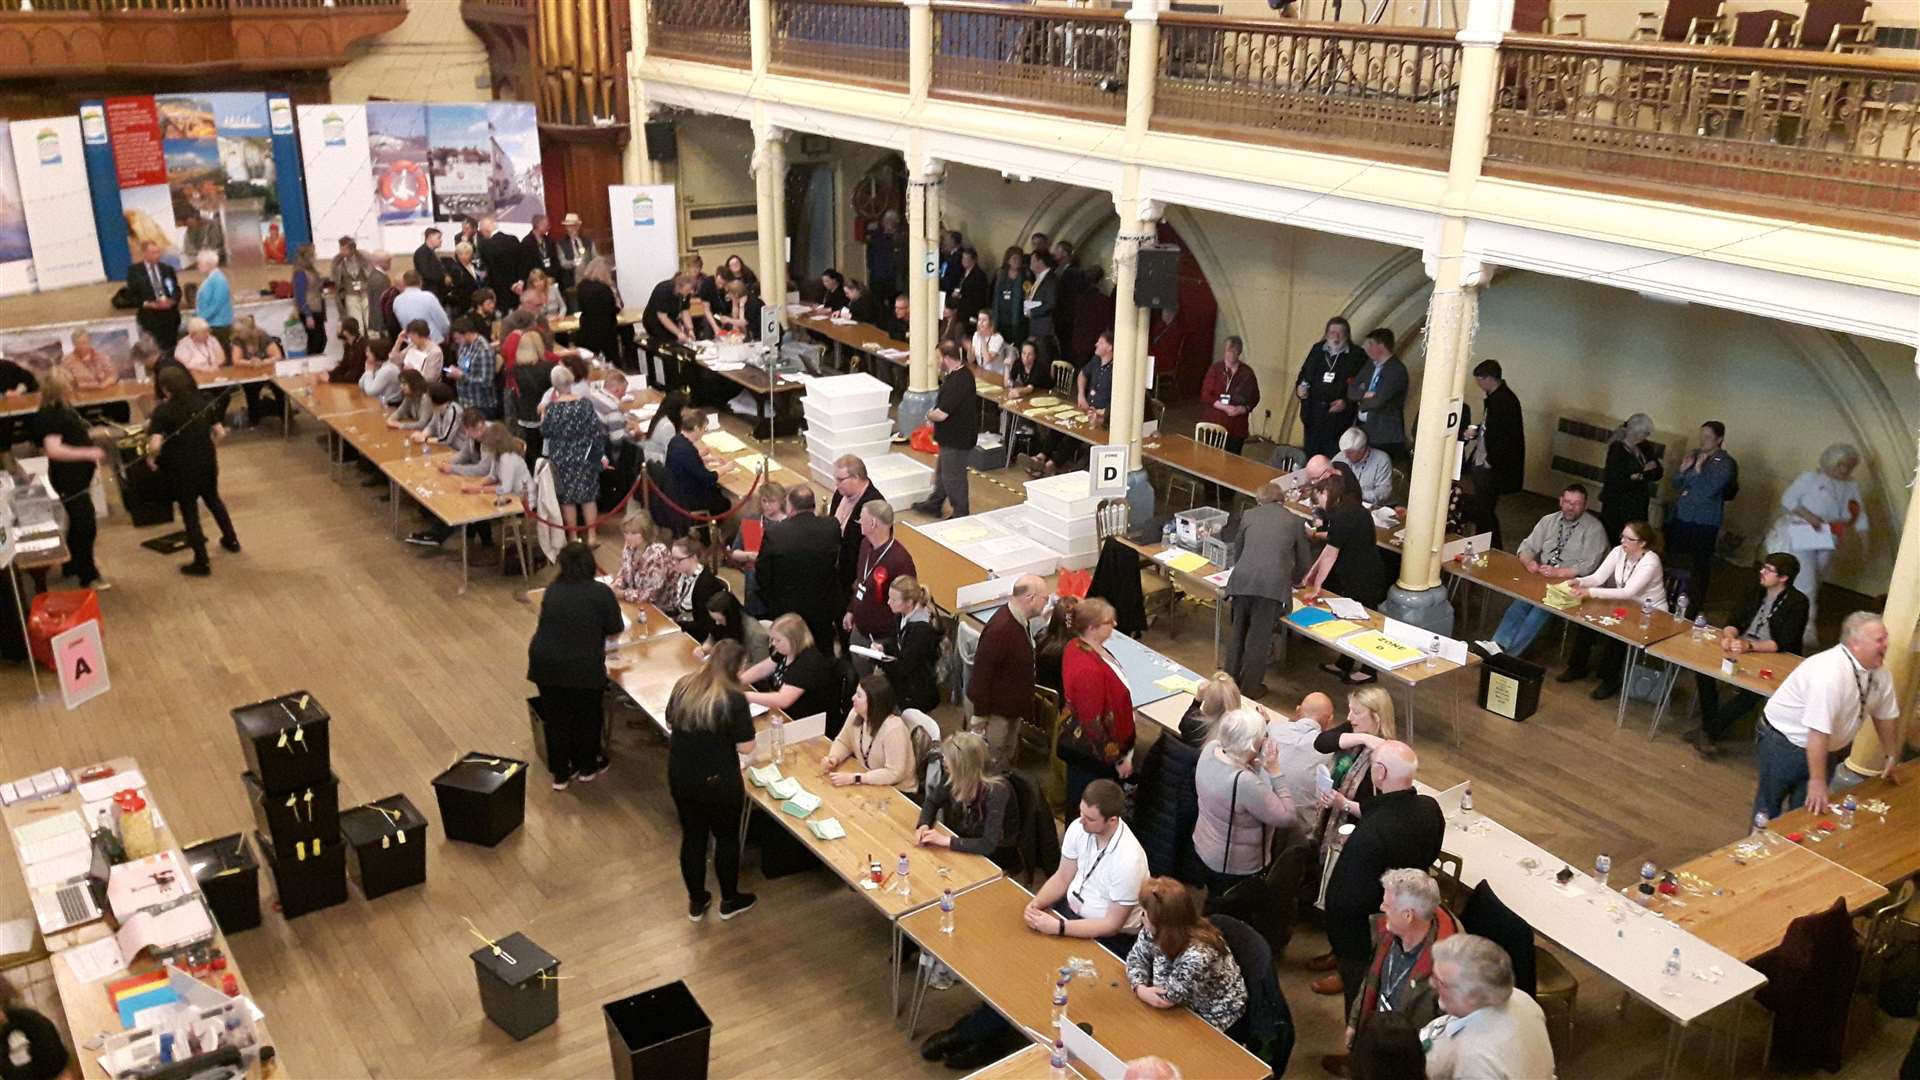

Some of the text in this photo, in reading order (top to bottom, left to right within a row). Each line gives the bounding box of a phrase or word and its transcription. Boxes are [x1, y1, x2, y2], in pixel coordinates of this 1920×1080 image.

[926, 261, 935, 273] C
[1447, 411, 1458, 429] D
[1103, 466, 1118, 481] D
[1377, 637, 1407, 650] ZONE
[75, 656, 93, 681] A
